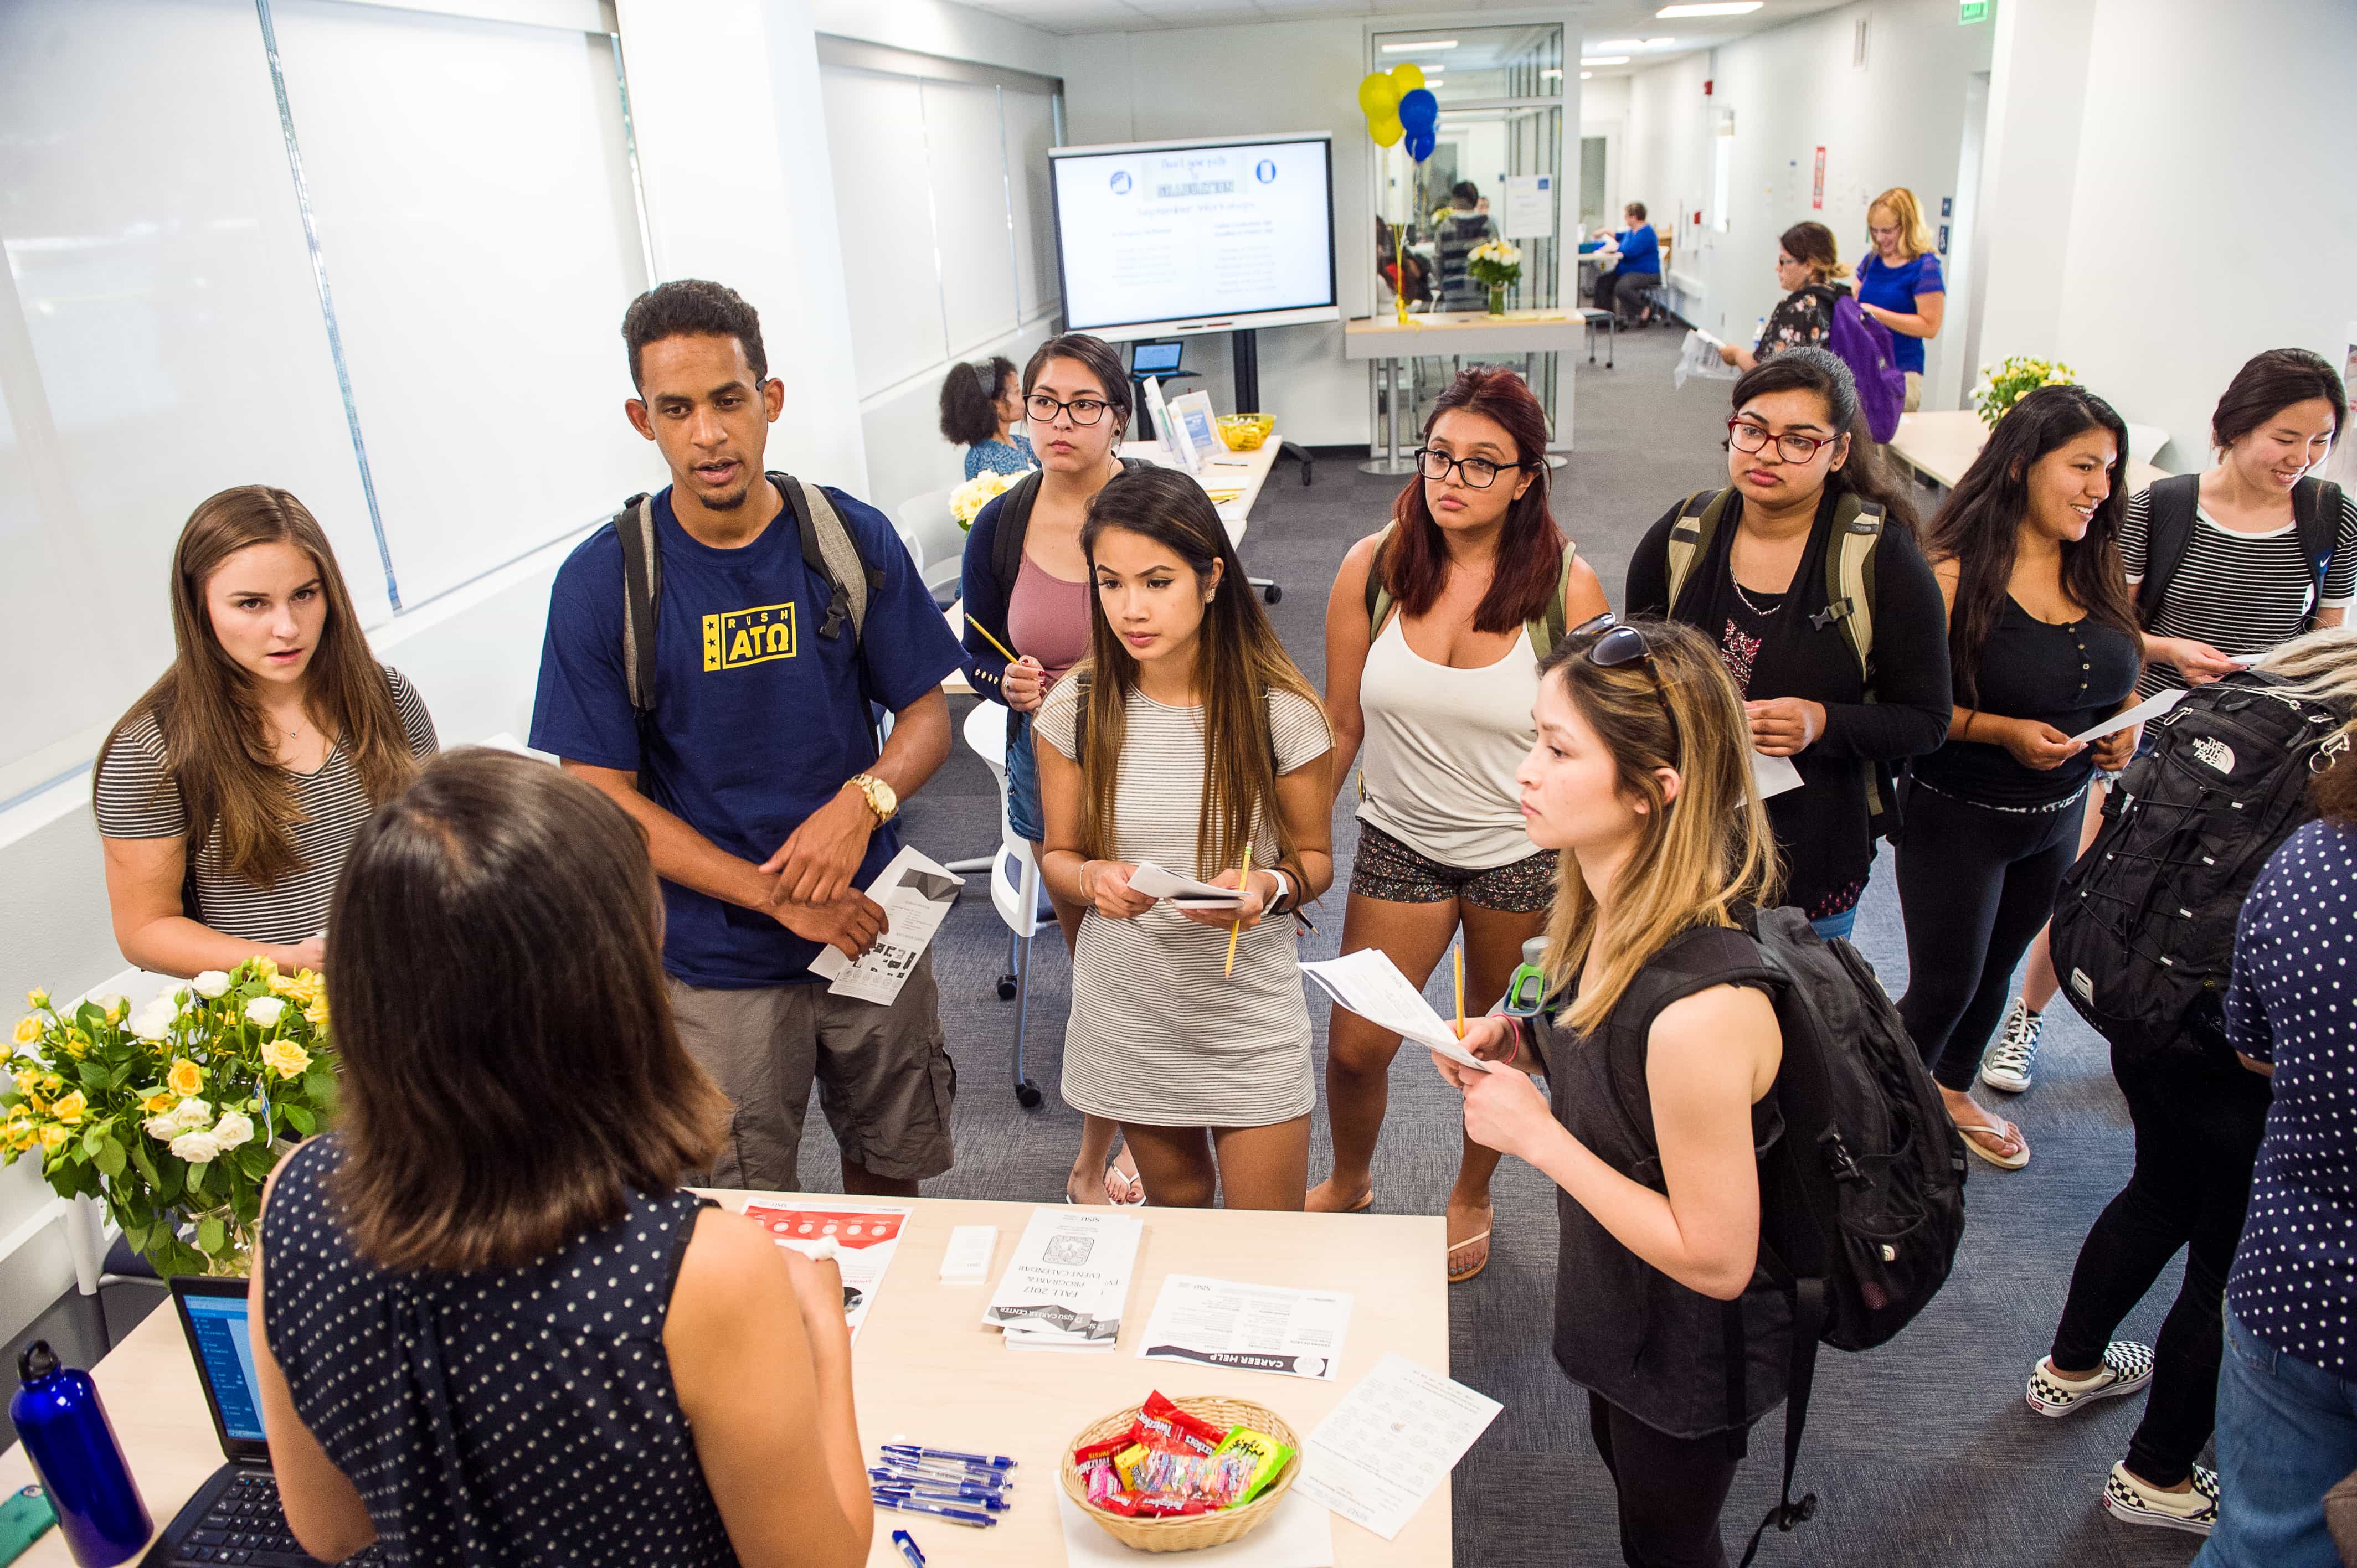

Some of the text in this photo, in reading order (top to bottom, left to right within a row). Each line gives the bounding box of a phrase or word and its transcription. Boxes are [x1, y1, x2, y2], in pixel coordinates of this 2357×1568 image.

[728, 610, 788, 629] RUSH
[2192, 738, 2220, 758] NORTH
[2207, 736, 2225, 751] THE
[2194, 751, 2217, 765] FACE
[1054, 1289, 1078, 1298] FALL
[1000, 1307, 1075, 1322] SJSU CAREER CENTER
[1210, 1353, 1284, 1368] CAREER HELP
